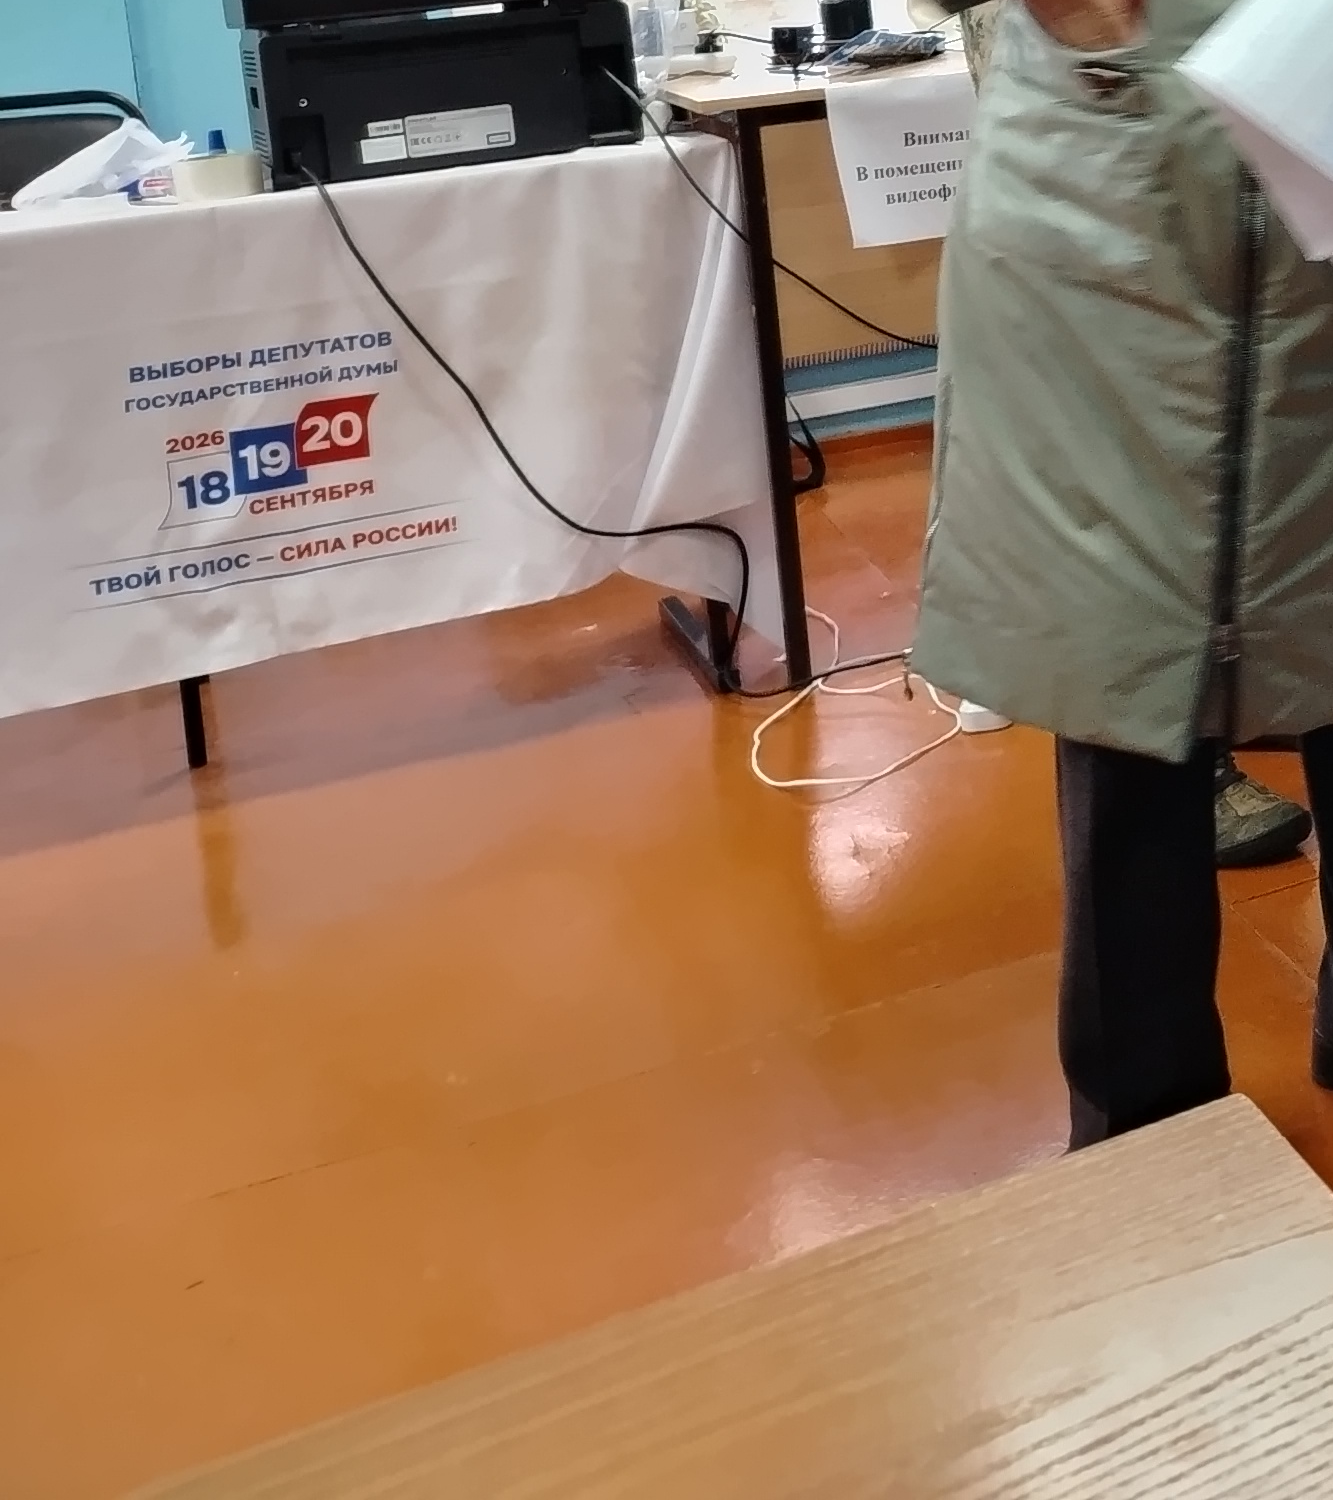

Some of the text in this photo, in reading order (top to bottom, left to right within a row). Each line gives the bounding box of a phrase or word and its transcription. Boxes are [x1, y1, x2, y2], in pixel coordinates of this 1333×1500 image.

[856, 166, 868, 181] В
[128, 330, 393, 384] ВЫБОРЫ ДЕПУТАТОВ
[124, 359, 399, 414] ГОСУДАРСТВЕННОЙ ДУМЫ
[165, 430, 225, 455] 2026
[178, 411, 363, 510] 18 19 20
[248, 478, 375, 516] СЕНТЯБРЯ
[89, 565, 162, 596] ТВОЙ
[168, 551, 251, 584] ГОЛОС
[279, 536, 346, 563] СИЛА
[352, 516, 458, 550] РОССИИ!
